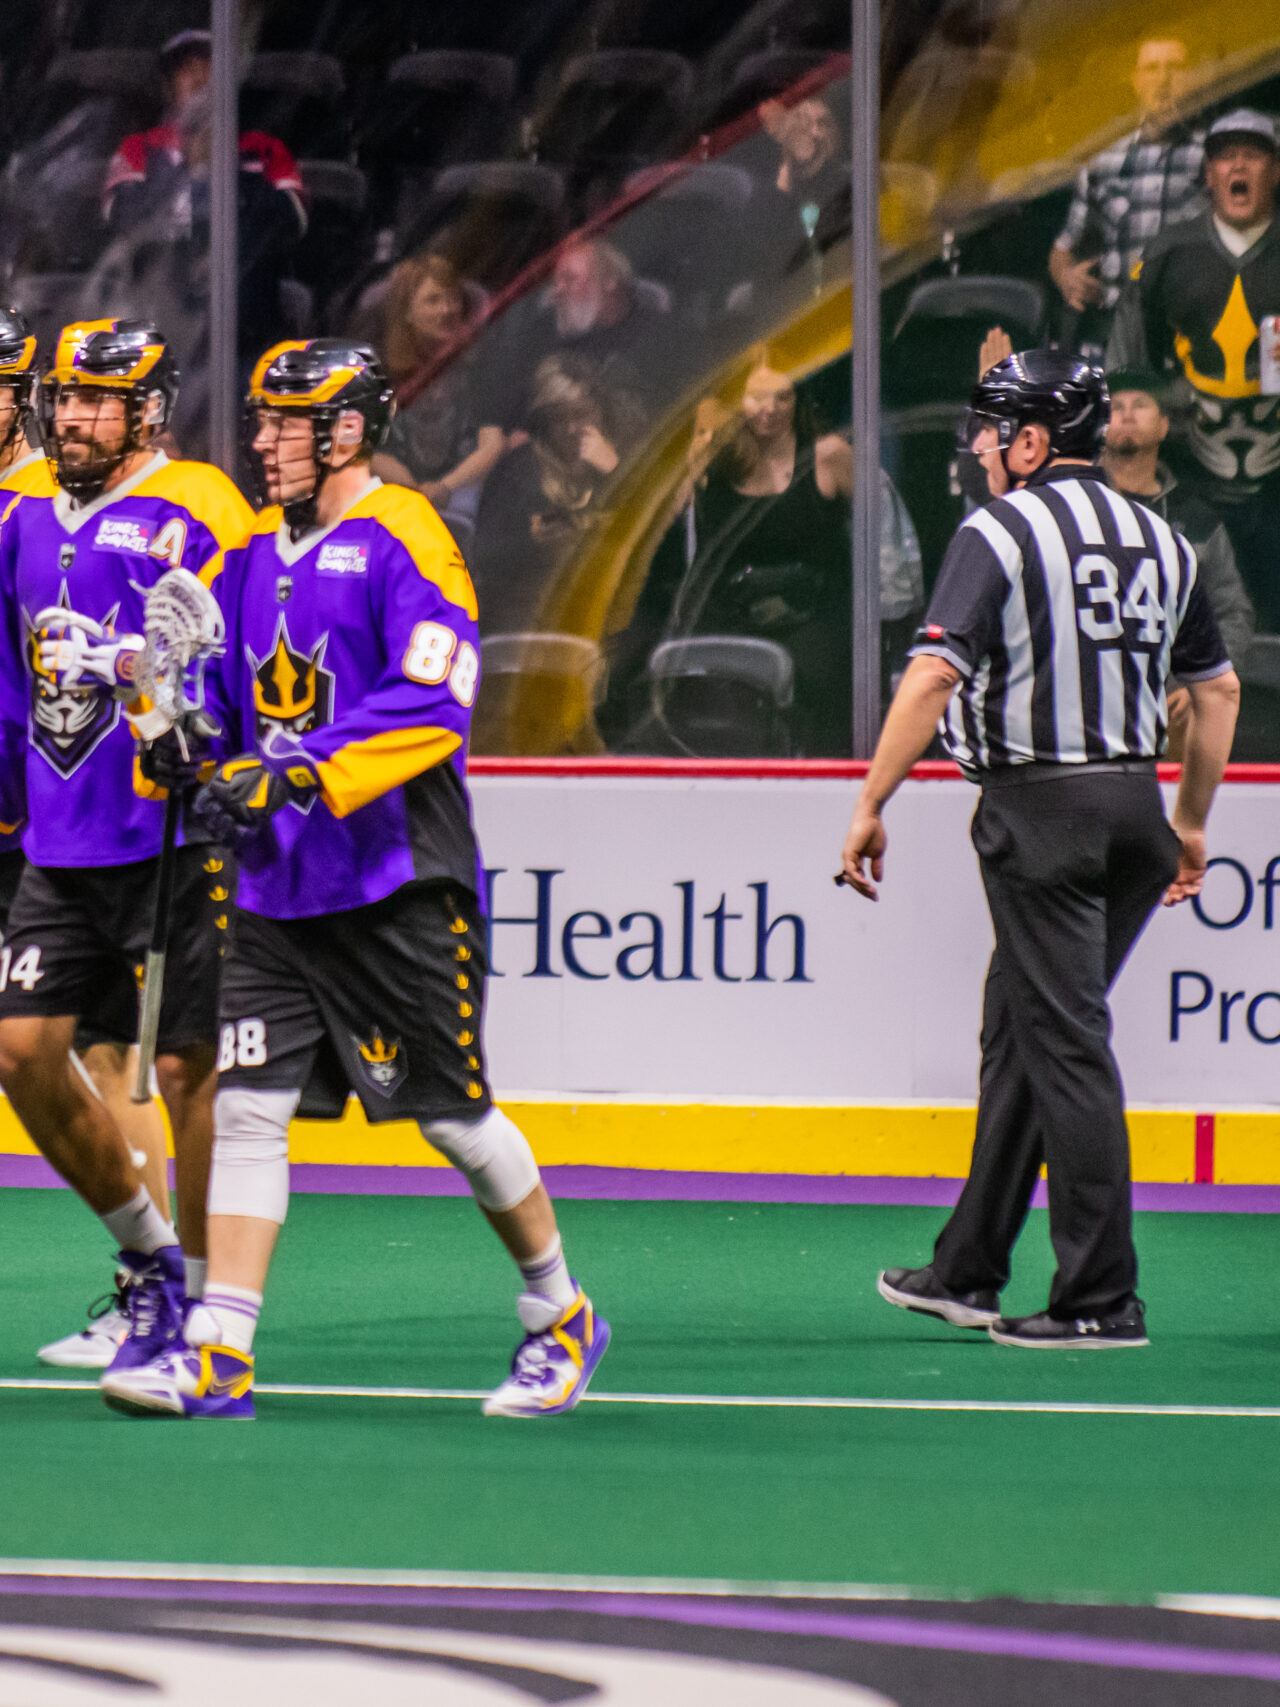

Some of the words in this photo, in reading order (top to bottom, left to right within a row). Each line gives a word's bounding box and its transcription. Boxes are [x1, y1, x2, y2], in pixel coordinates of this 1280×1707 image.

[147, 518, 188, 568] A
[1075, 553, 1167, 644] 34
[401, 620, 480, 708] 88
[484, 868, 815, 983] Health
[1191, 857, 1280, 930] Of
[216, 1017, 268, 1073] 88
[1170, 970, 1280, 1045] Pro
